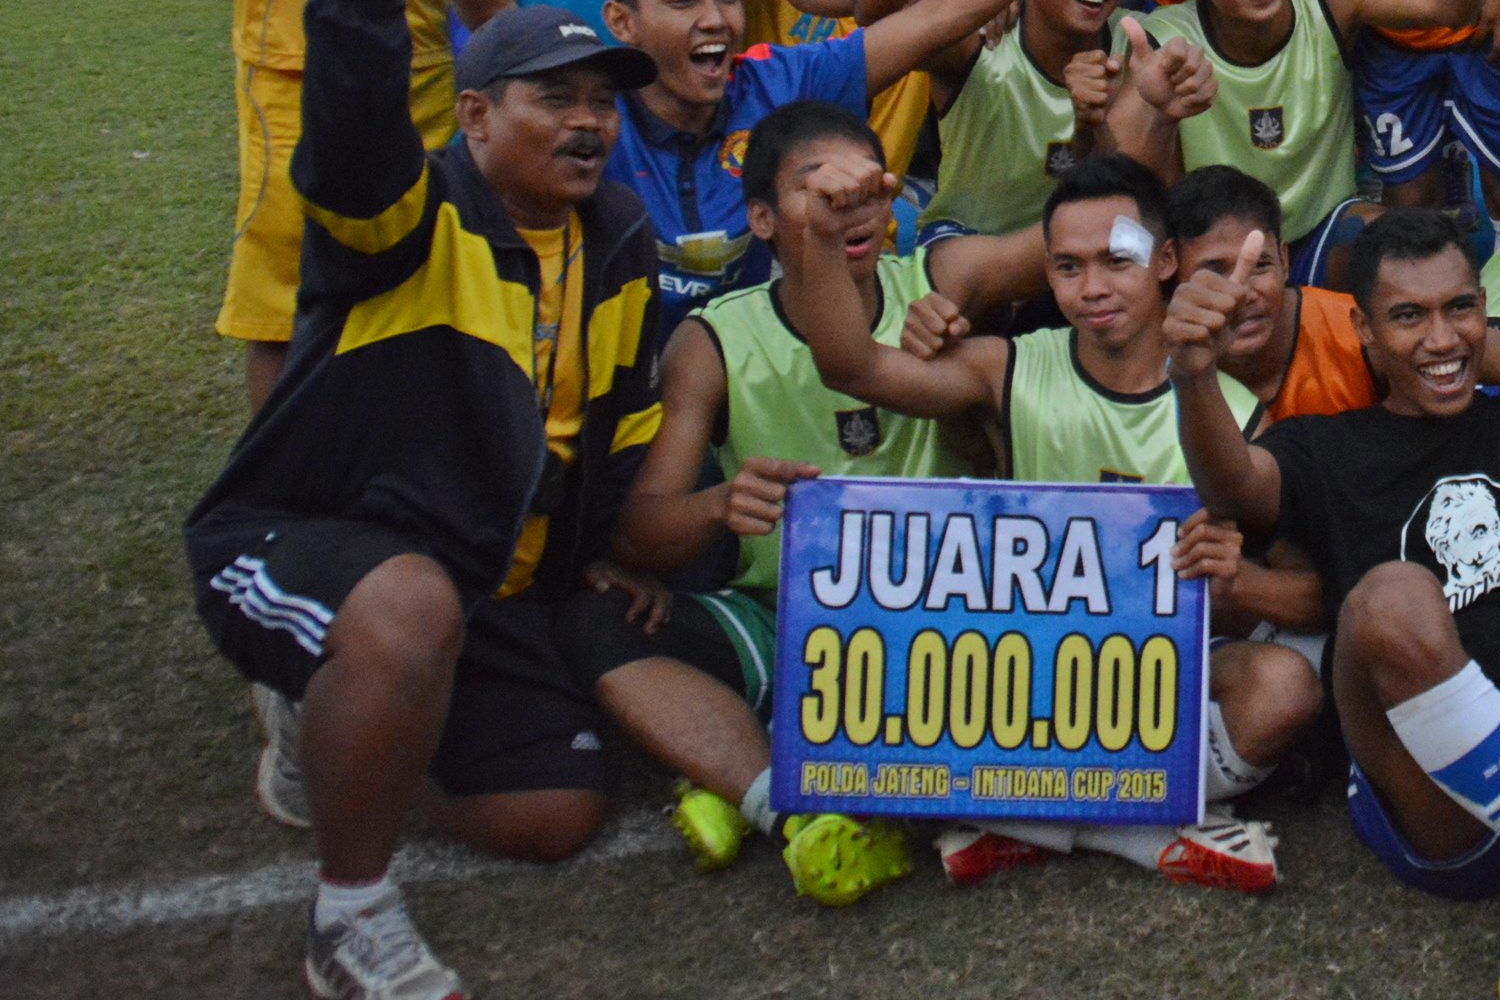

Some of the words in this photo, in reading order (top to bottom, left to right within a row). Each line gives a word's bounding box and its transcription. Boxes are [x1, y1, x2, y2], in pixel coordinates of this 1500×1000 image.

[811, 510, 1113, 615] JUARA
[1138, 517, 1184, 619] 1
[799, 624, 1180, 755] 30.000.000
[801, 764, 868, 797] POLDA
[871, 766, 951, 800] JATENG
[971, 766, 1070, 802] INTIDANA
[1070, 768, 1116, 803] CUP
[1116, 769, 1168, 803] 2015
